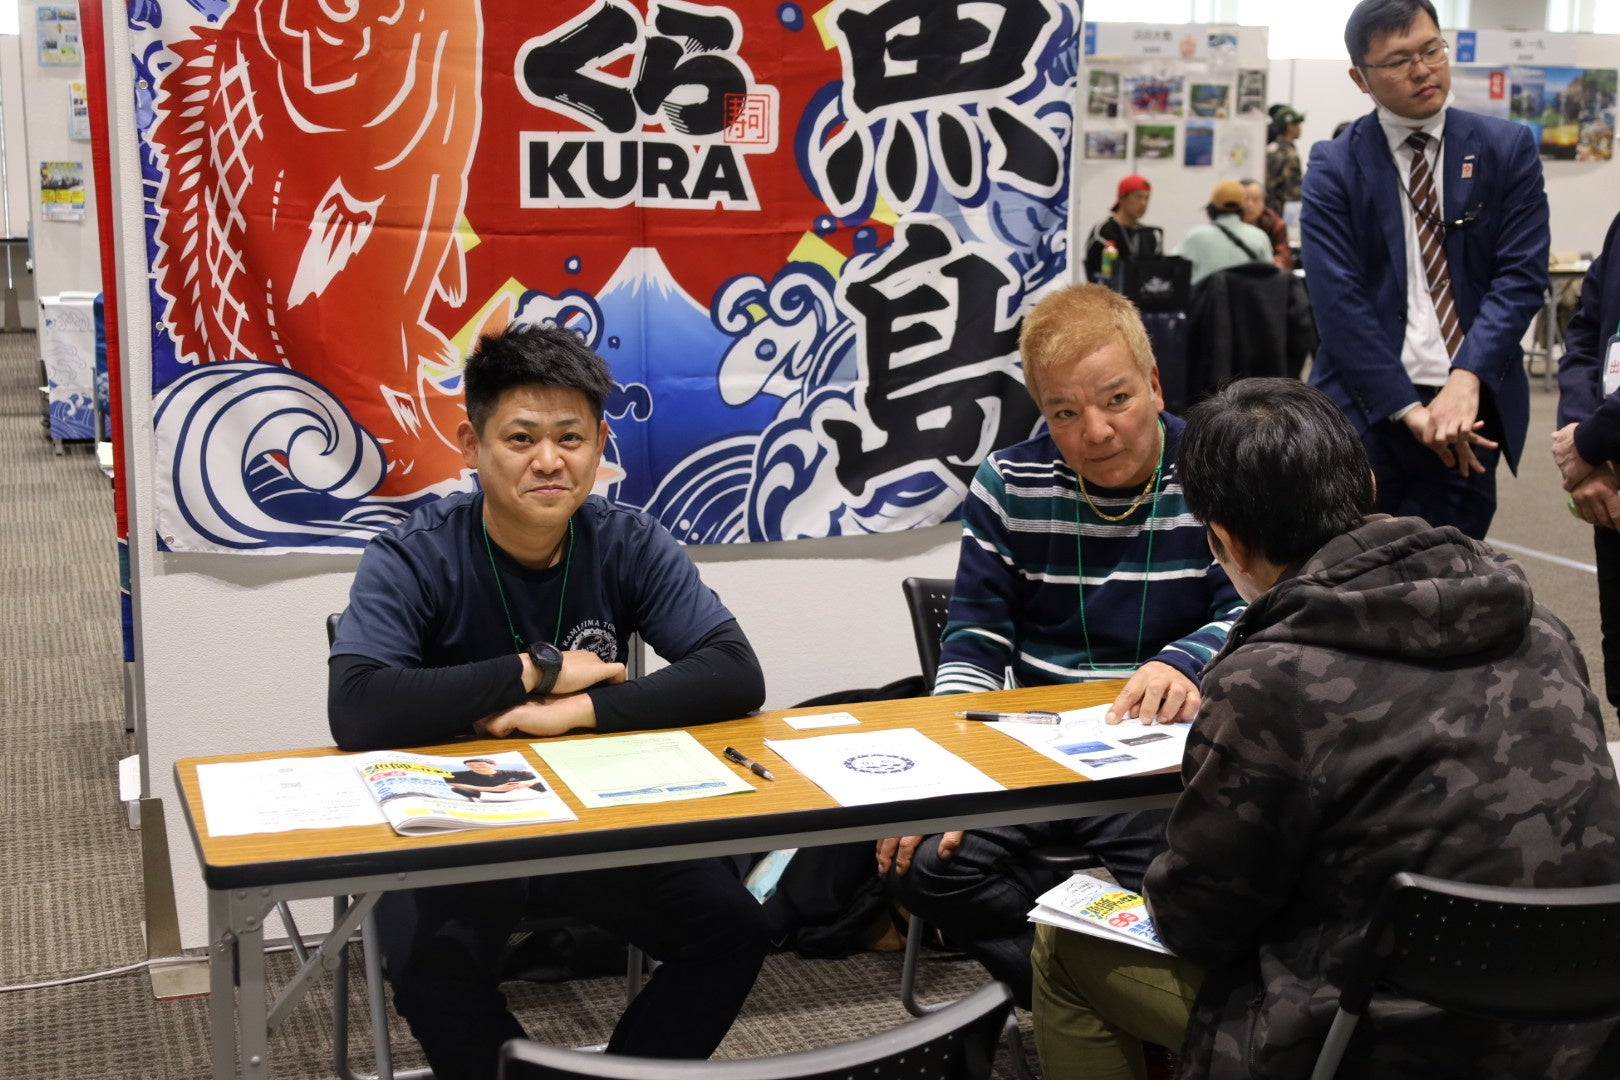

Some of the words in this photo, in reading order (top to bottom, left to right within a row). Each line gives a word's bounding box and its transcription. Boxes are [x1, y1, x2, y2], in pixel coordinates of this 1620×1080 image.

[523, 0, 748, 135] くら
[529, 140, 748, 201] KURA
[822, 0, 1062, 497] 黒島
[562, 619, 600, 647] KAMIJIMA
